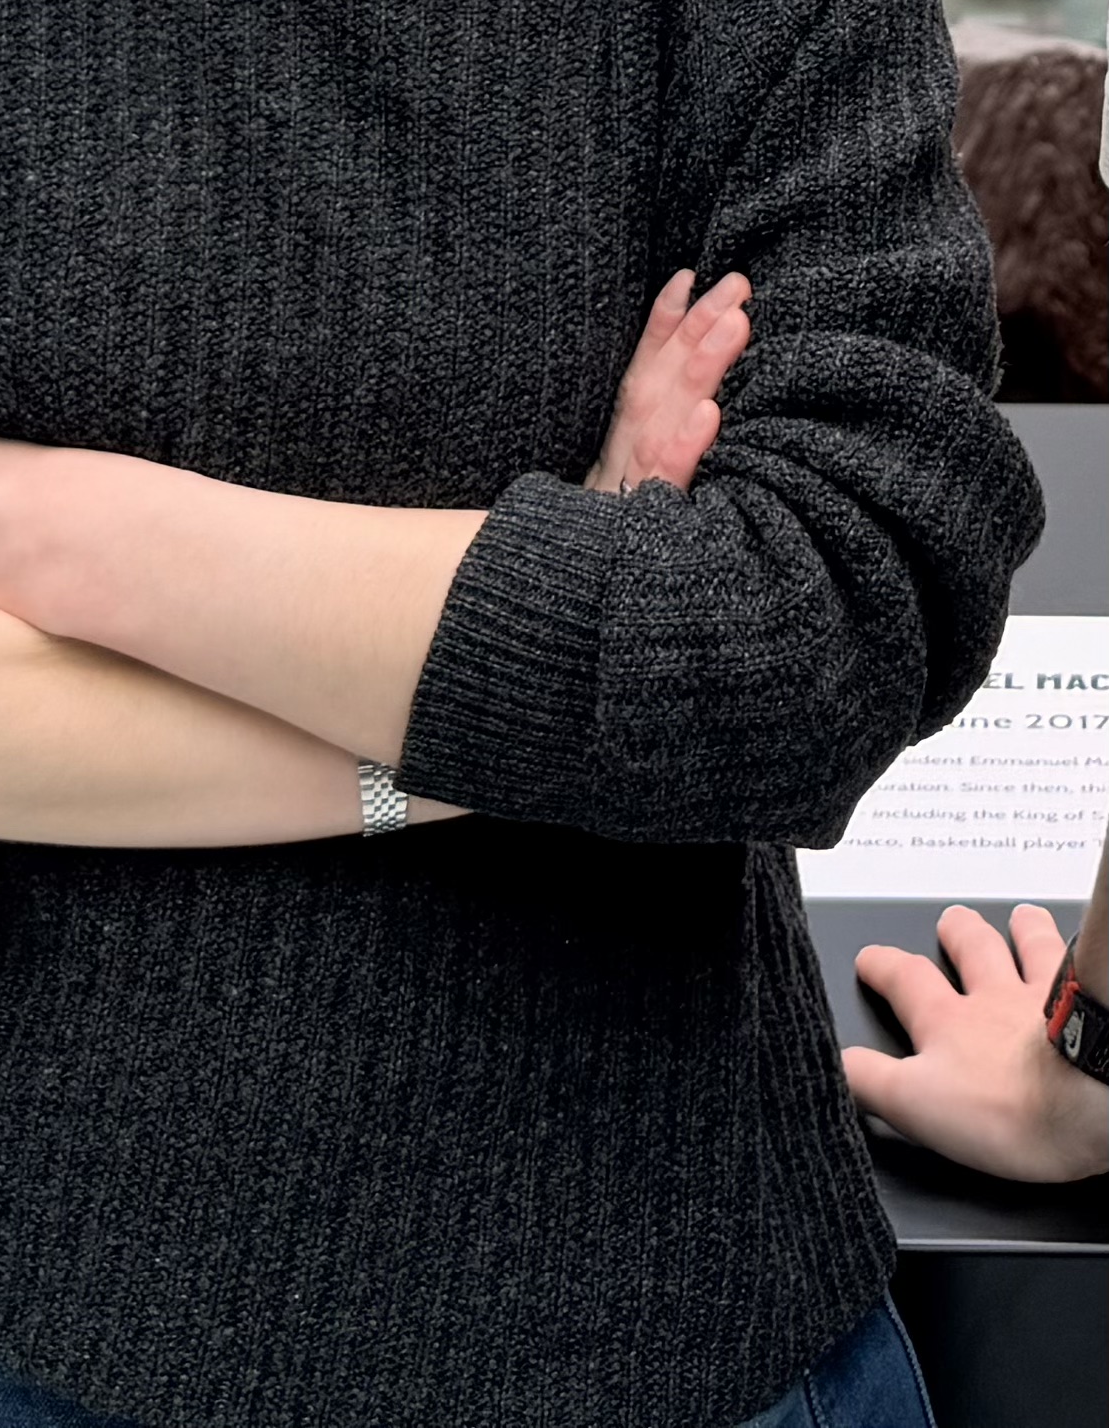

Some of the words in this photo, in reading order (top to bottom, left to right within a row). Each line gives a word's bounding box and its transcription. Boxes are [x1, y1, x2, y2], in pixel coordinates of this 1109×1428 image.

[982, 671, 1025, 691] EL
[1036, 672, 1109, 691] MAC
[951, 715, 1013, 730] une
[1025, 713, 1109, 730] 2017
[903, 754, 964, 767] sident
[969, 755, 1079, 767] Emmanuel
[960, 781, 1016, 794] Since
[871, 807, 968, 823] including
[972, 808, 1007, 821] the
[1012, 808, 1059, 824] King
[1063, 808, 1085, 822] of
[910, 835, 1017, 849] Basketball
[1022, 835, 1088, 852] player
